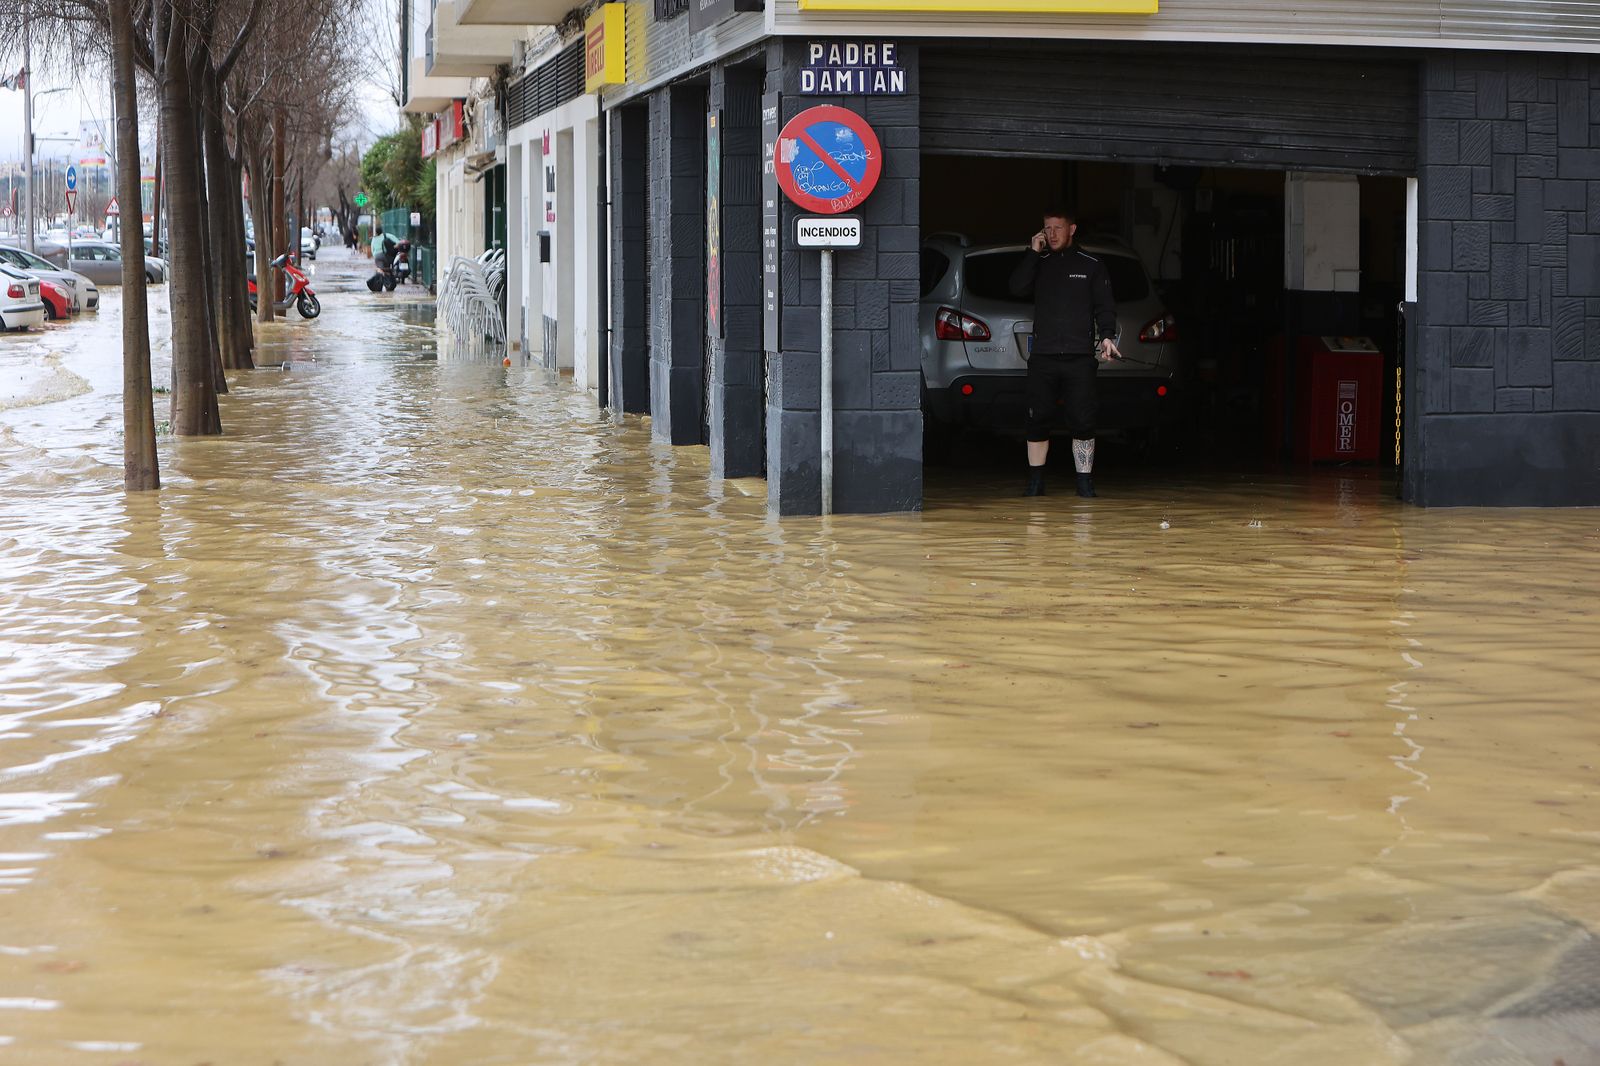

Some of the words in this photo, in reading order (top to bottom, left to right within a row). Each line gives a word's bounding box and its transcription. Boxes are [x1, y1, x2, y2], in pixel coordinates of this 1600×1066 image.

[587, 22, 605, 79] PIRELLI
[810, 43, 895, 65] PADRE
[801, 70, 904, 92] DAMIAN
[800, 227, 857, 237] INCENDIOS
[1338, 400, 1354, 450] OMER
